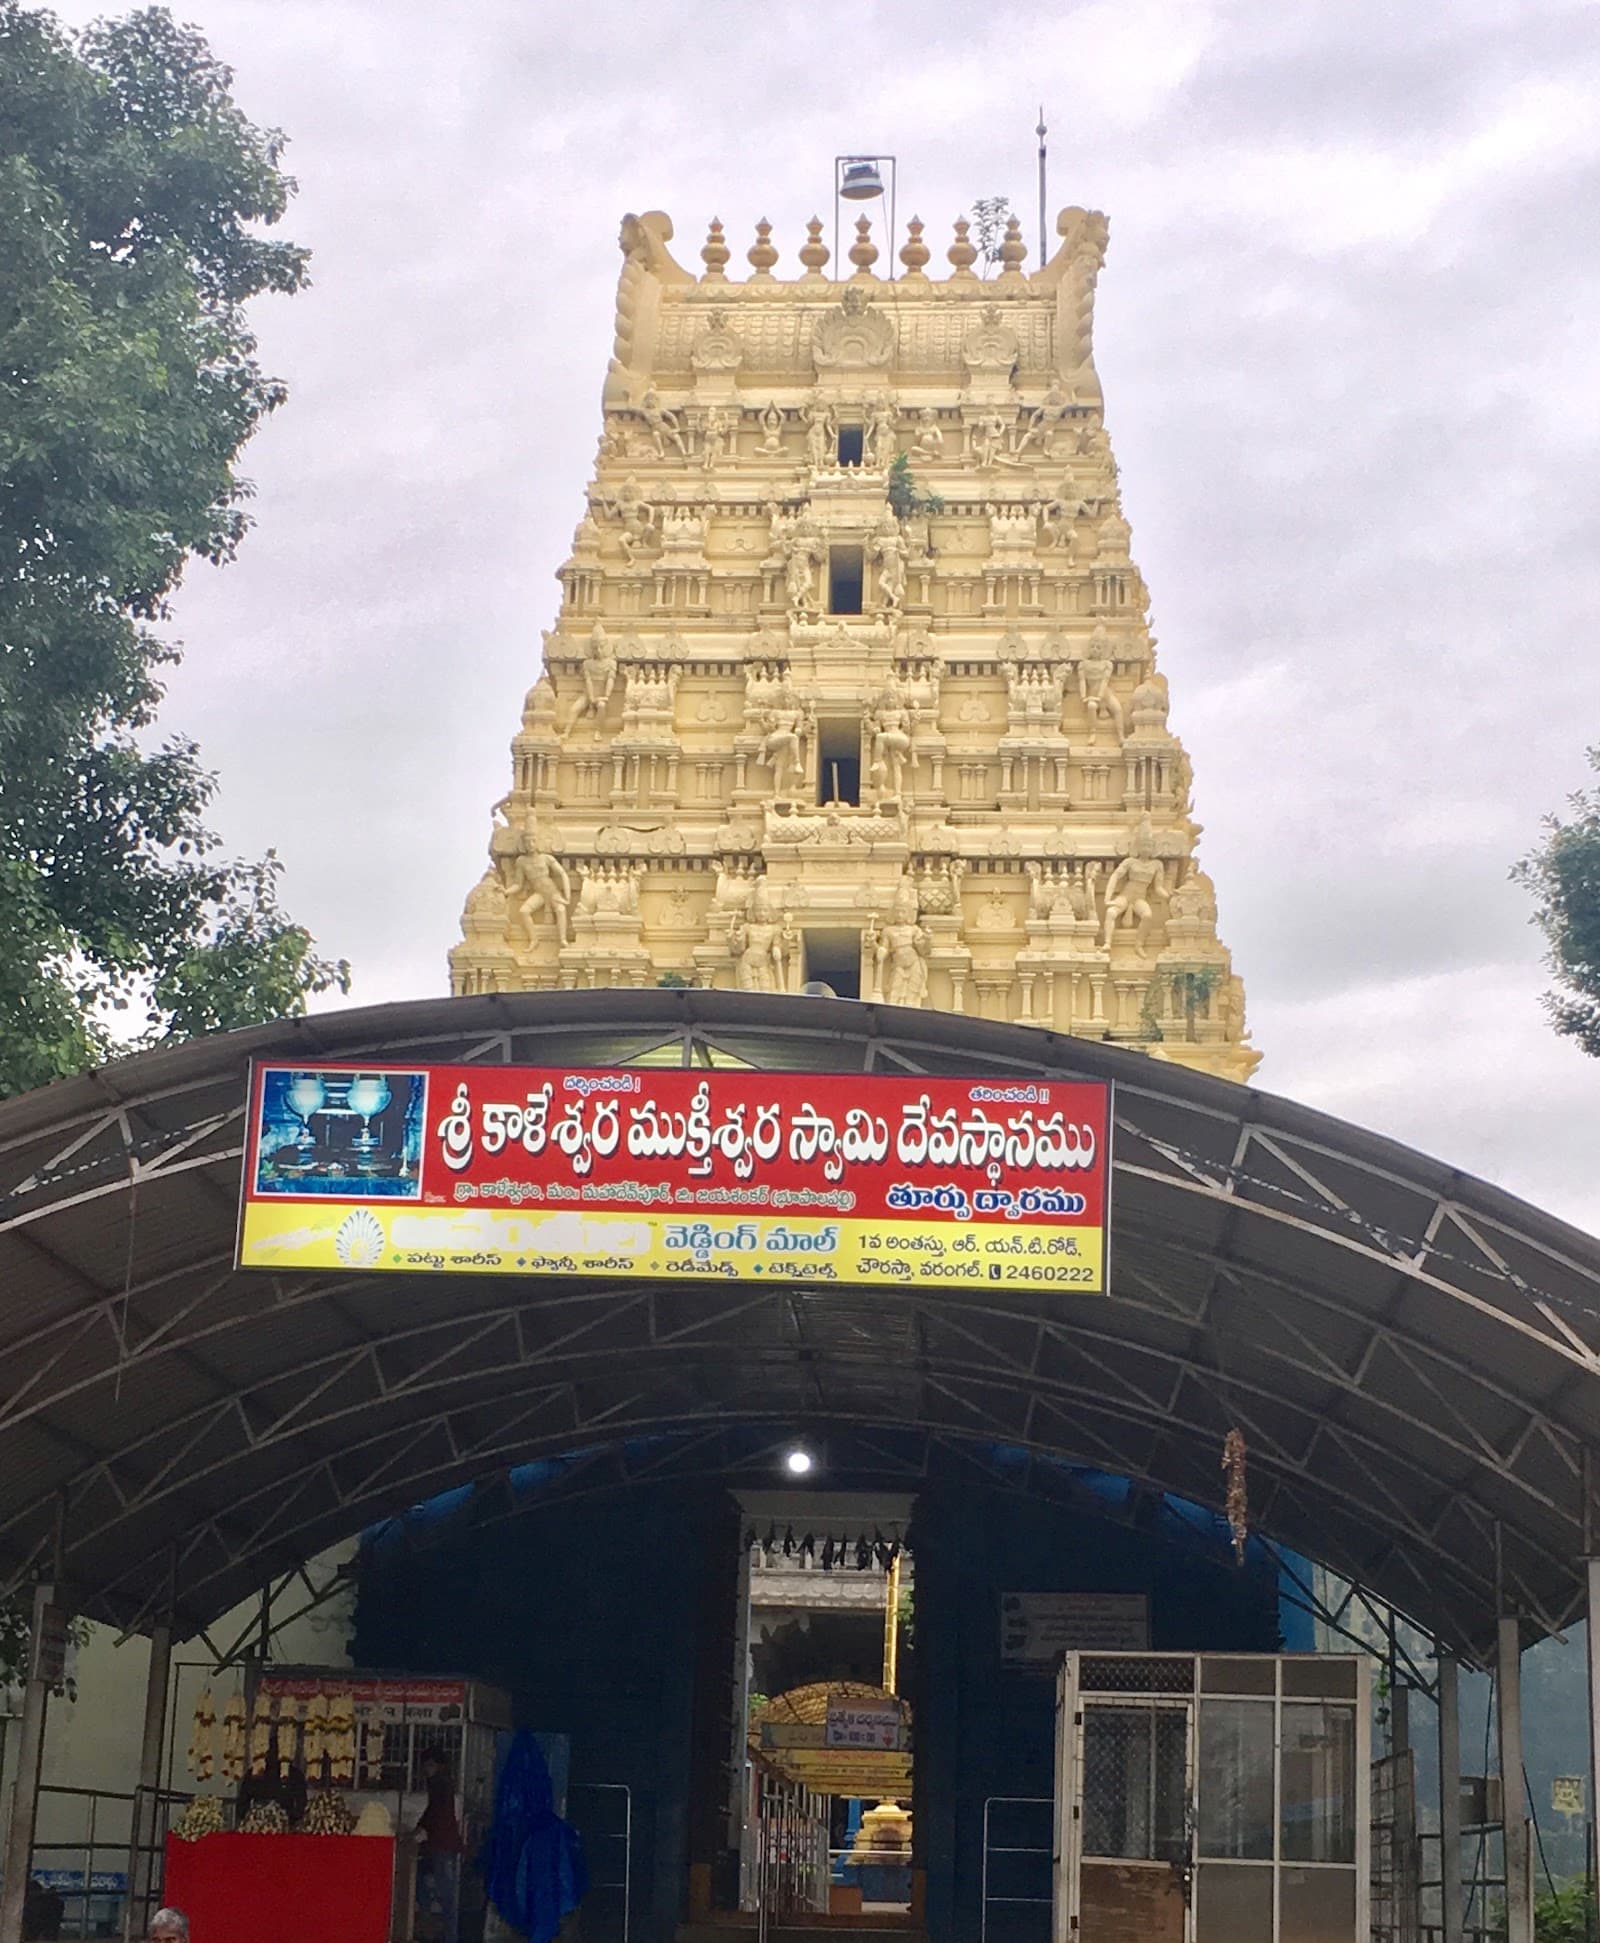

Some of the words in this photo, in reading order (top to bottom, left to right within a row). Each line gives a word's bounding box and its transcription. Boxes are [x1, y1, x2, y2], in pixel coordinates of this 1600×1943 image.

[438, 1082, 473, 1169] శ్రీ
[481, 1082, 619, 1174] కాళేశ్వర
[627, 1081, 781, 1178] ముక్తీశ్వర
[789, 1102, 888, 1180] స్వామి
[897, 1094, 1096, 1186] దేవస్థానము
[887, 1182, 972, 1218] తూర్పు
[974, 1187, 1085, 1217] ద్వారము
[665, 1223, 757, 1259] వెడ్డింగ్
[766, 1225, 839, 1252] మాల్
[1006, 1265, 1094, 1282] 2460222
